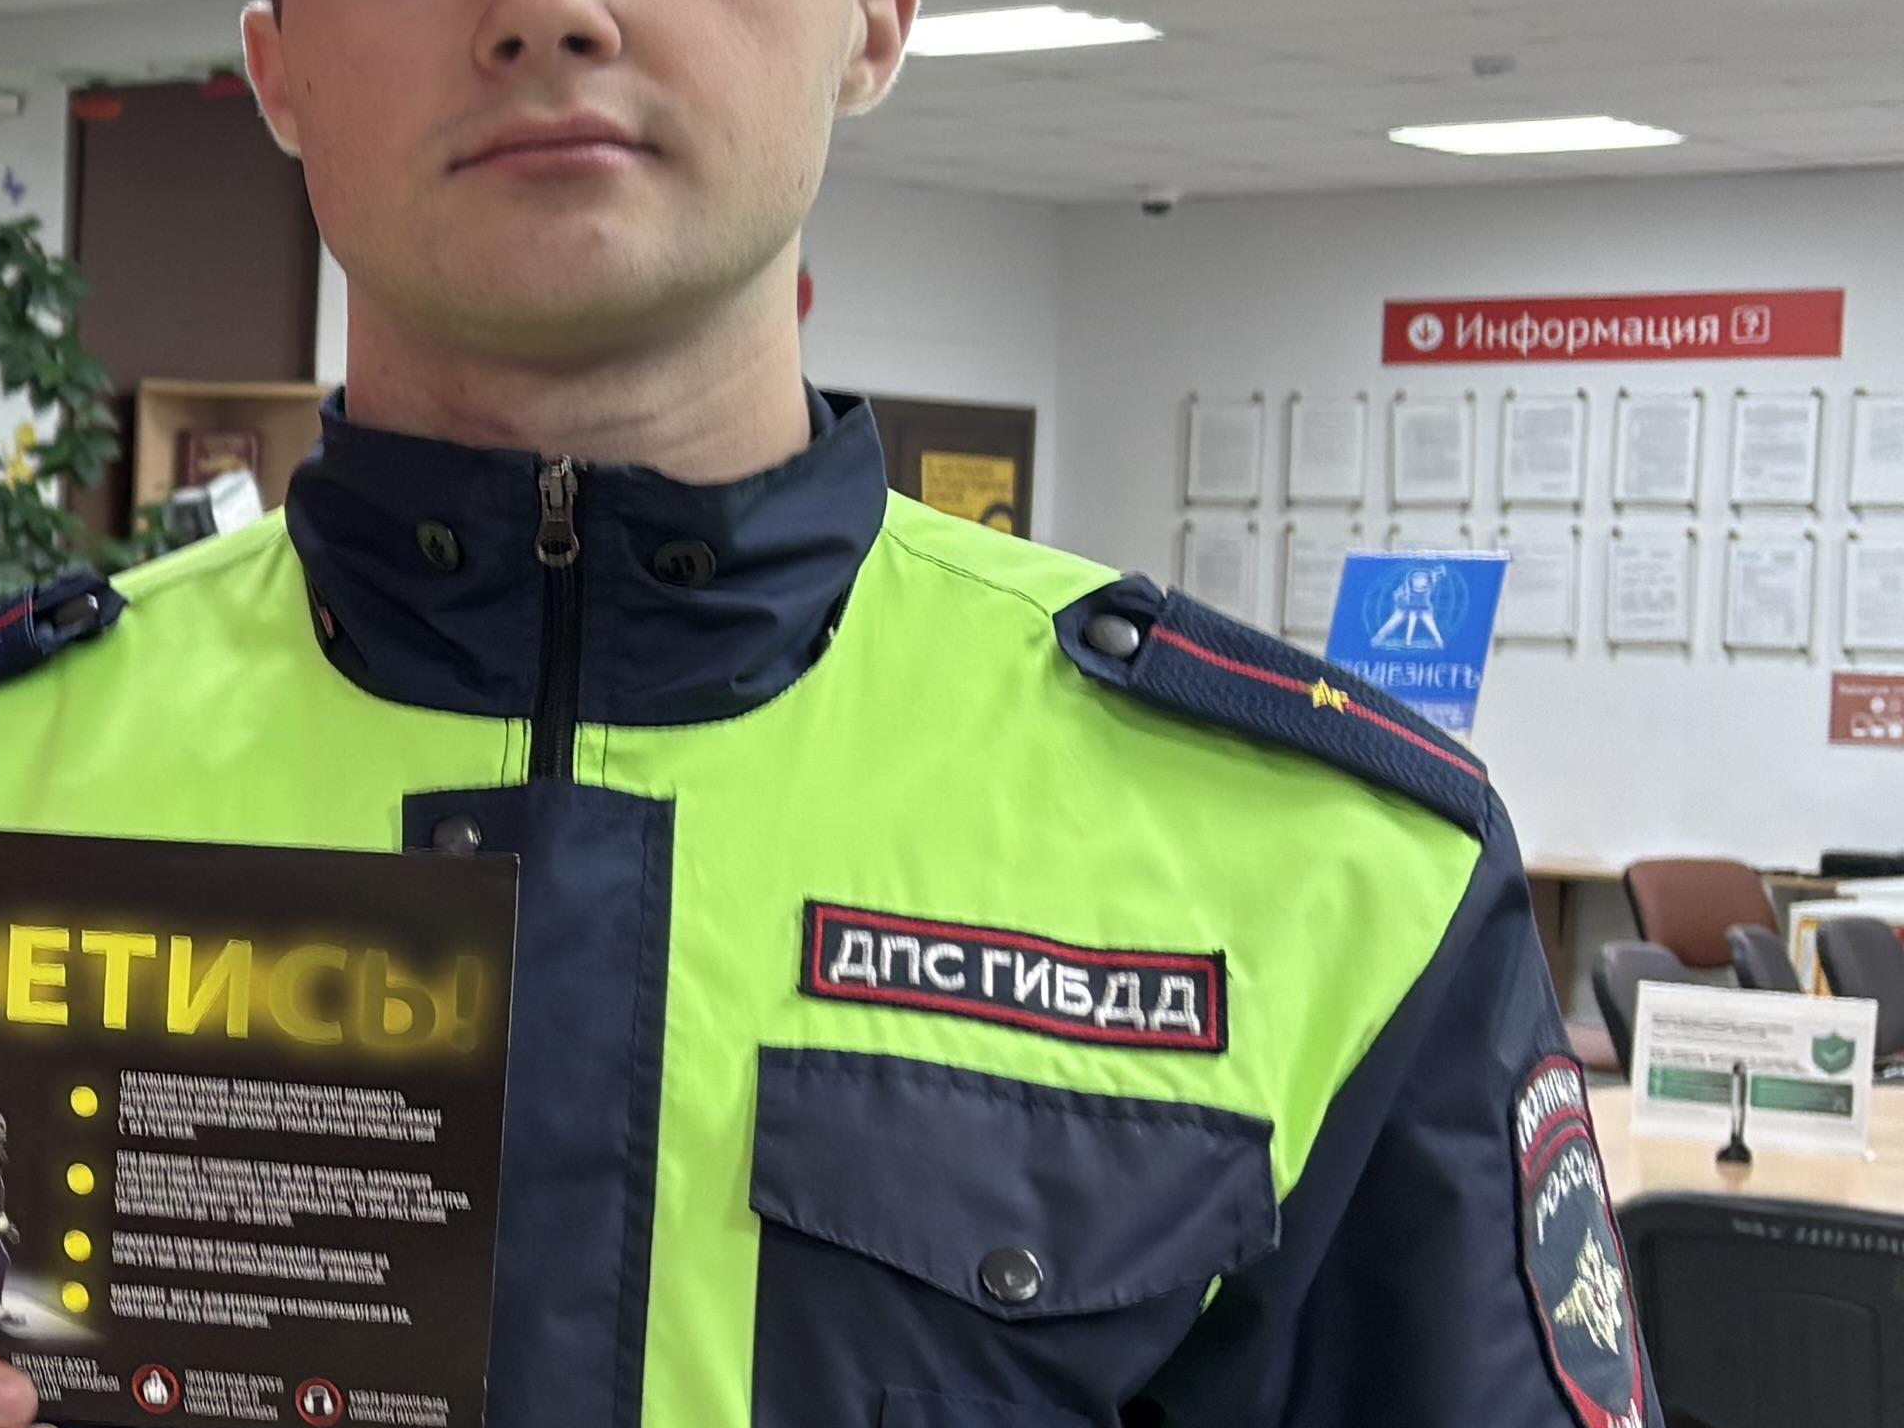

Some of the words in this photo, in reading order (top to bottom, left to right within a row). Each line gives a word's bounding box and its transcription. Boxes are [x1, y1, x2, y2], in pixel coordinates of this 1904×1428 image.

[1453, 310, 1720, 357] Информация
[828, 928, 966, 990] ДПС
[980, 948, 1203, 1036] ГИБДД
